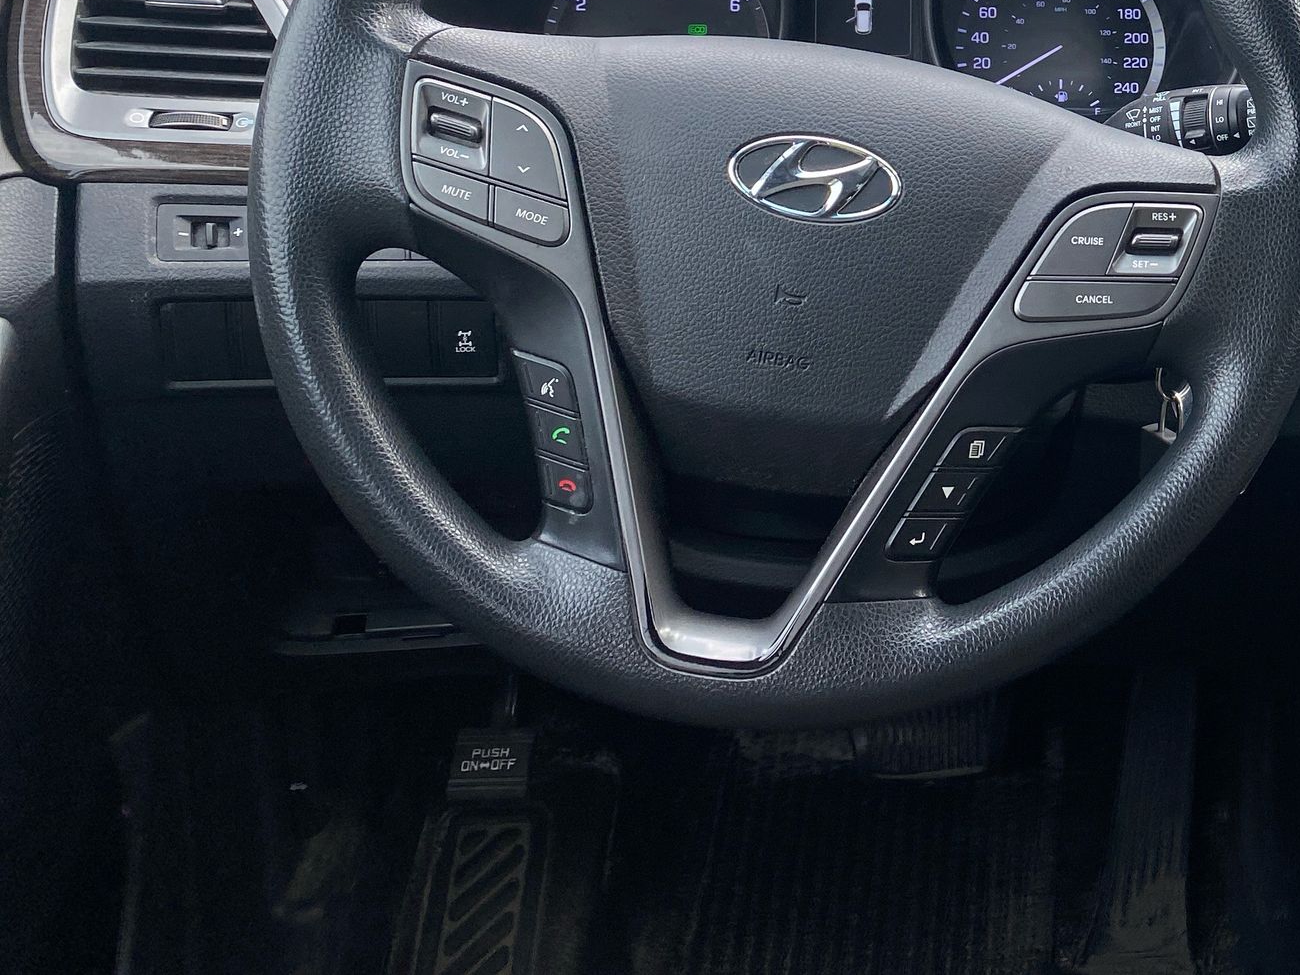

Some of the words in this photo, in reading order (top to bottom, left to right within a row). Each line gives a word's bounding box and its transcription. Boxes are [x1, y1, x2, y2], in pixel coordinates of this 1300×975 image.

[730, 0, 740, 12] 6
[979, 7, 997, 18] 60
[1117, 8, 1141, 20] 180
[971, 32, 989, 43] 40
[1124, 33, 1149, 44] 200
[973, 57, 991, 69] 20
[1123, 57, 1148, 69] 220
[1114, 82, 1139, 94] 240
[1149, 106, 1163, 114] MIST
[1125, 120, 1141, 129] FRONT
[441, 184, 472, 201] MUTE
[515, 208, 549, 225] MODE
[1071, 236, 1104, 246] CRUISE
[1075, 295, 1113, 304] CANCEL
[746, 349, 811, 371] AIRBAG
[472, 748, 510, 758] PUSH
[461, 760, 478, 772] ON
[490, 758, 516, 770] OFF
